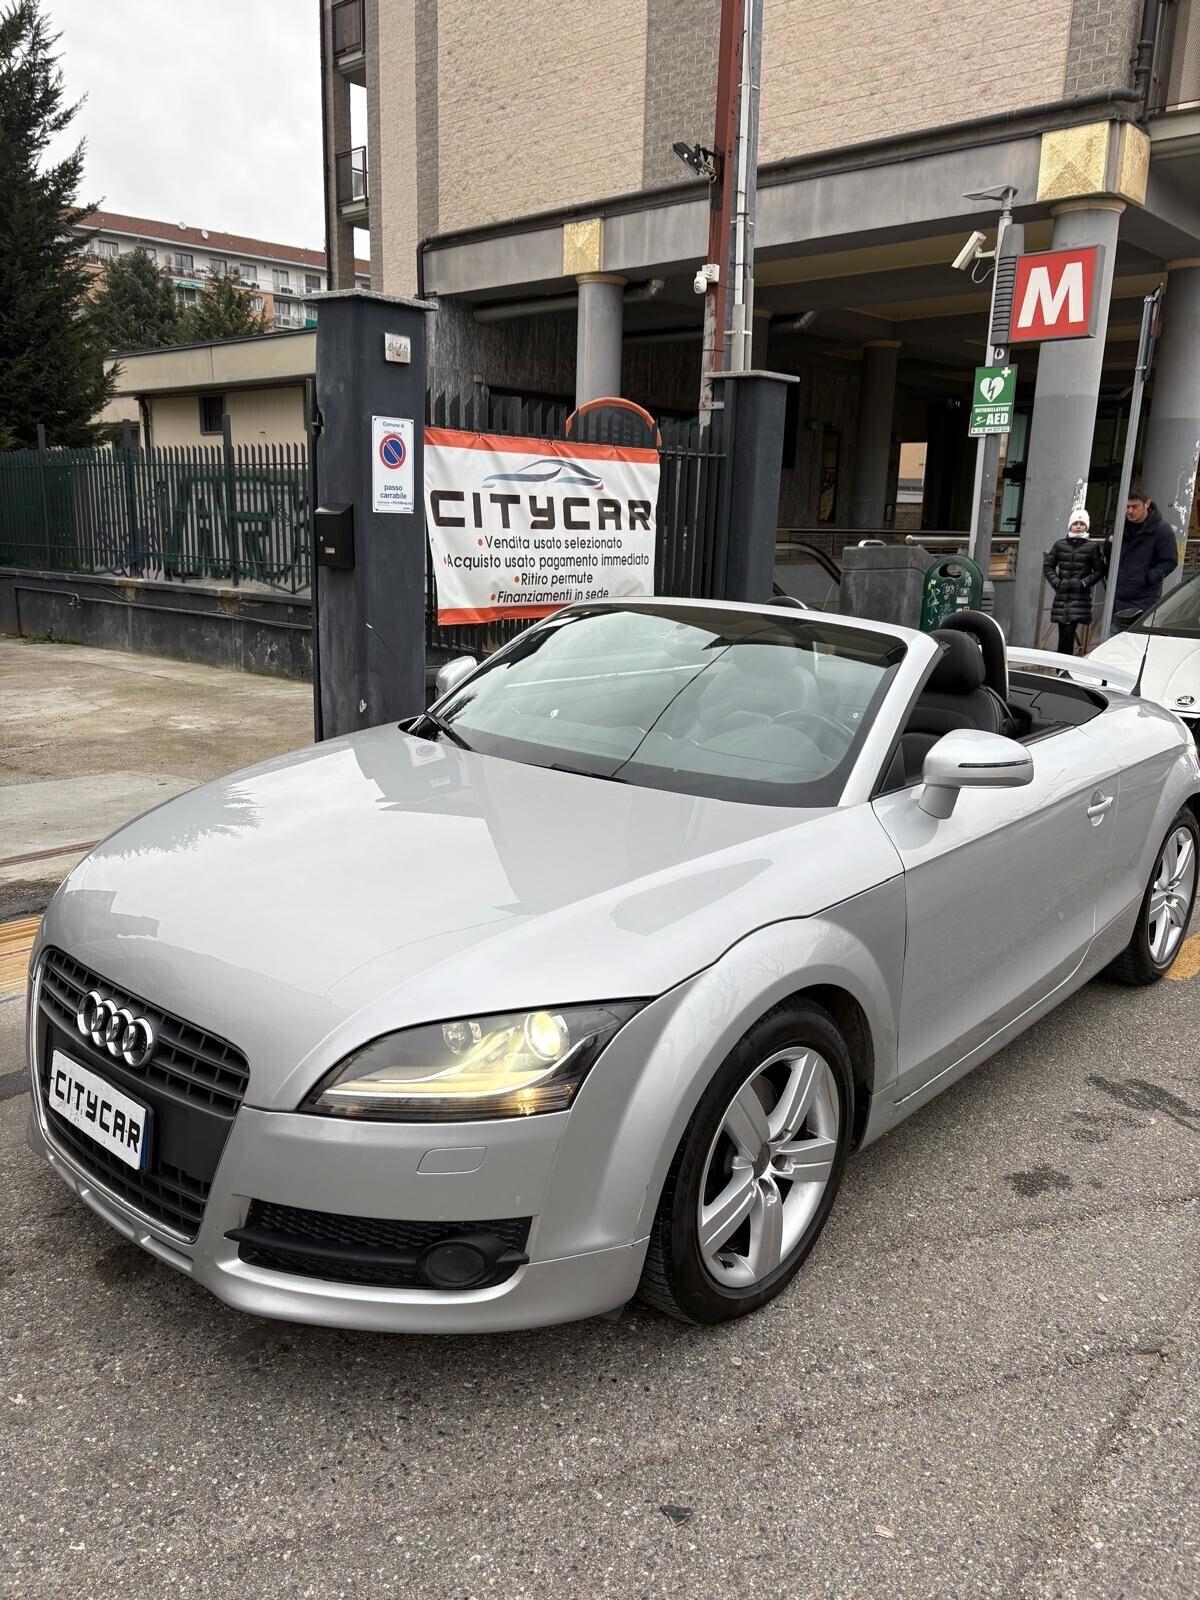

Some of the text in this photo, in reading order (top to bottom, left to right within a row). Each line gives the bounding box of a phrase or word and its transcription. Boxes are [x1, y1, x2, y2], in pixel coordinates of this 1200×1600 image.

[1017, 261, 1085, 328] M
[986, 413, 1009, 425] AED
[380, 492, 407, 500] carrabile
[430, 489, 652, 531] CITYCAR
[485, 536, 623, 549] Vendita usato selezionato
[447, 553, 650, 571] Acquisto usato pagamento immediato
[521, 572, 594, 587] Ritiro permute
[497, 587, 609, 604] Finanziamenti in sede
[54, 1069, 141, 1154] CITYCAR
